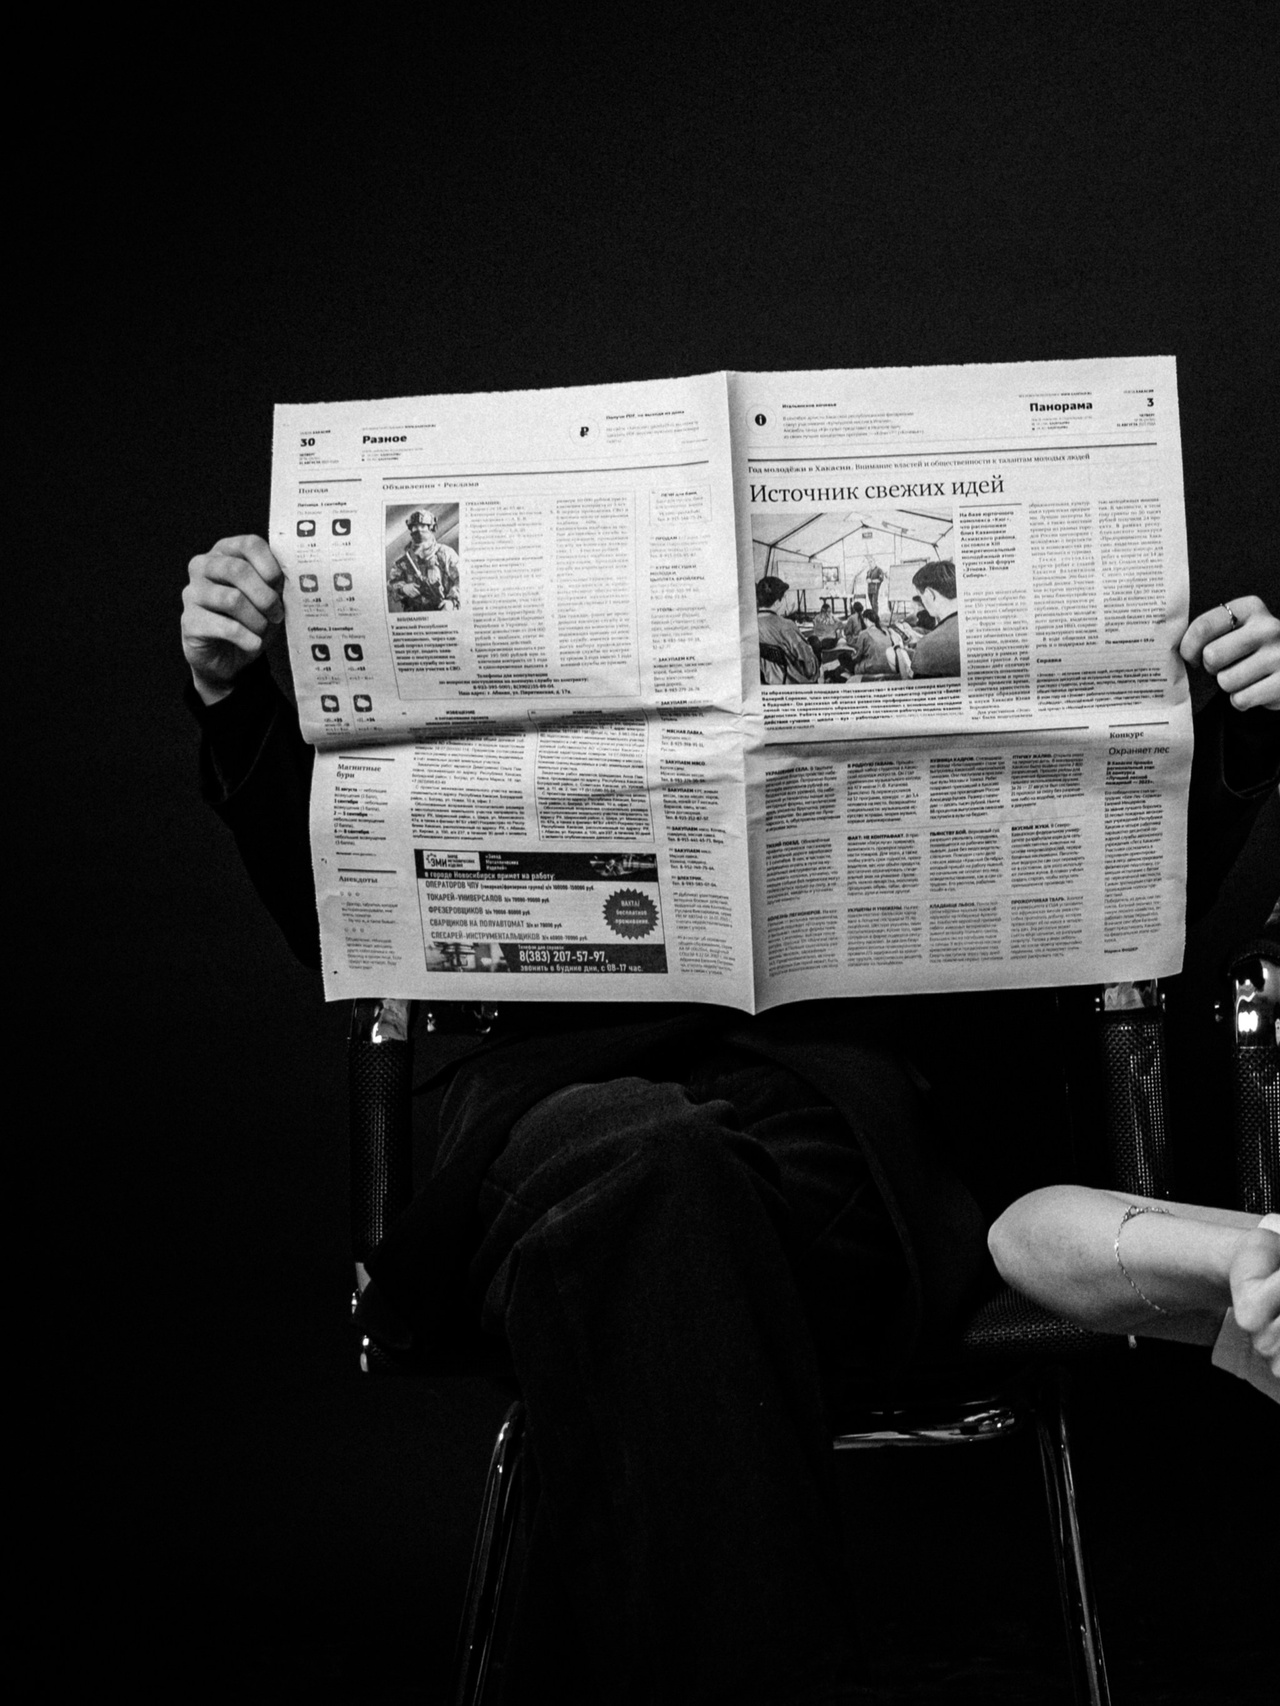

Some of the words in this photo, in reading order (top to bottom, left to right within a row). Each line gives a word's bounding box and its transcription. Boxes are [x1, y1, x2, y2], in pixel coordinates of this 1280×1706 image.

[1147, 397, 1154, 407] 3
[1030, 402, 1093, 413] Панорама
[300, 438, 315, 447] 30
[362, 435, 408, 444] Разное
[750, 484, 859, 503] Источник
[865, 481, 946, 499] свежих
[951, 474, 1005, 498] идей
[1110, 731, 1144, 739] Конкурс
[1109, 746, 1152, 757] Охраняет
[454, 871, 496, 880] Новосибирск
[427, 893, 502, 903] ТОКАРЕЙ-УНИВЕРСАЛОВ
[428, 906, 483, 915] ФРЕЗЕРОВЩИКОВ
[429, 919, 469, 928] СВАРЩИКОВ
[480, 920, 524, 928] ПОЛУАВТОМАТ
[519, 950, 550, 964] 8(383)
[554, 951, 609, 964] 207-57-97,
